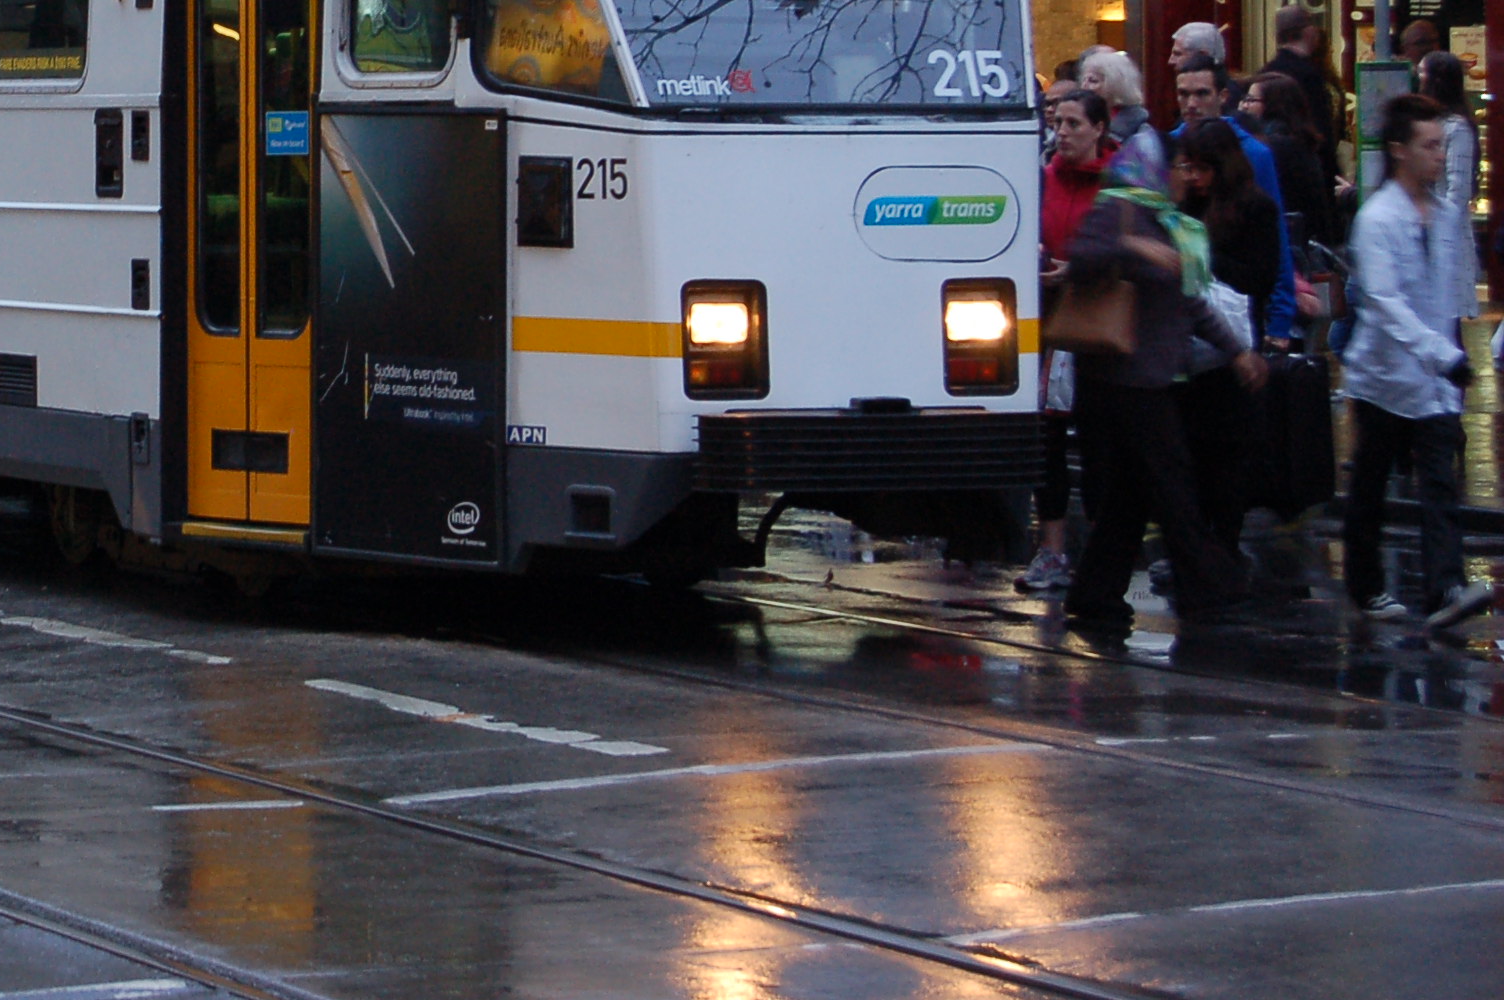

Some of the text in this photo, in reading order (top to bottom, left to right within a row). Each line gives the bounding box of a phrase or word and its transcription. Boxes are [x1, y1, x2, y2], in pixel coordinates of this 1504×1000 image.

[926, 49, 1011, 98] 215
[657, 74, 732, 97] metlink
[576, 157, 628, 200] 215
[874, 199, 996, 223] yarra trams
[374, 362, 458, 386] Suddenly, everything
[374, 382, 391, 396] else
[392, 383, 418, 397] seems
[509, 427, 544, 443] APN
[451, 508, 475, 525] intel
